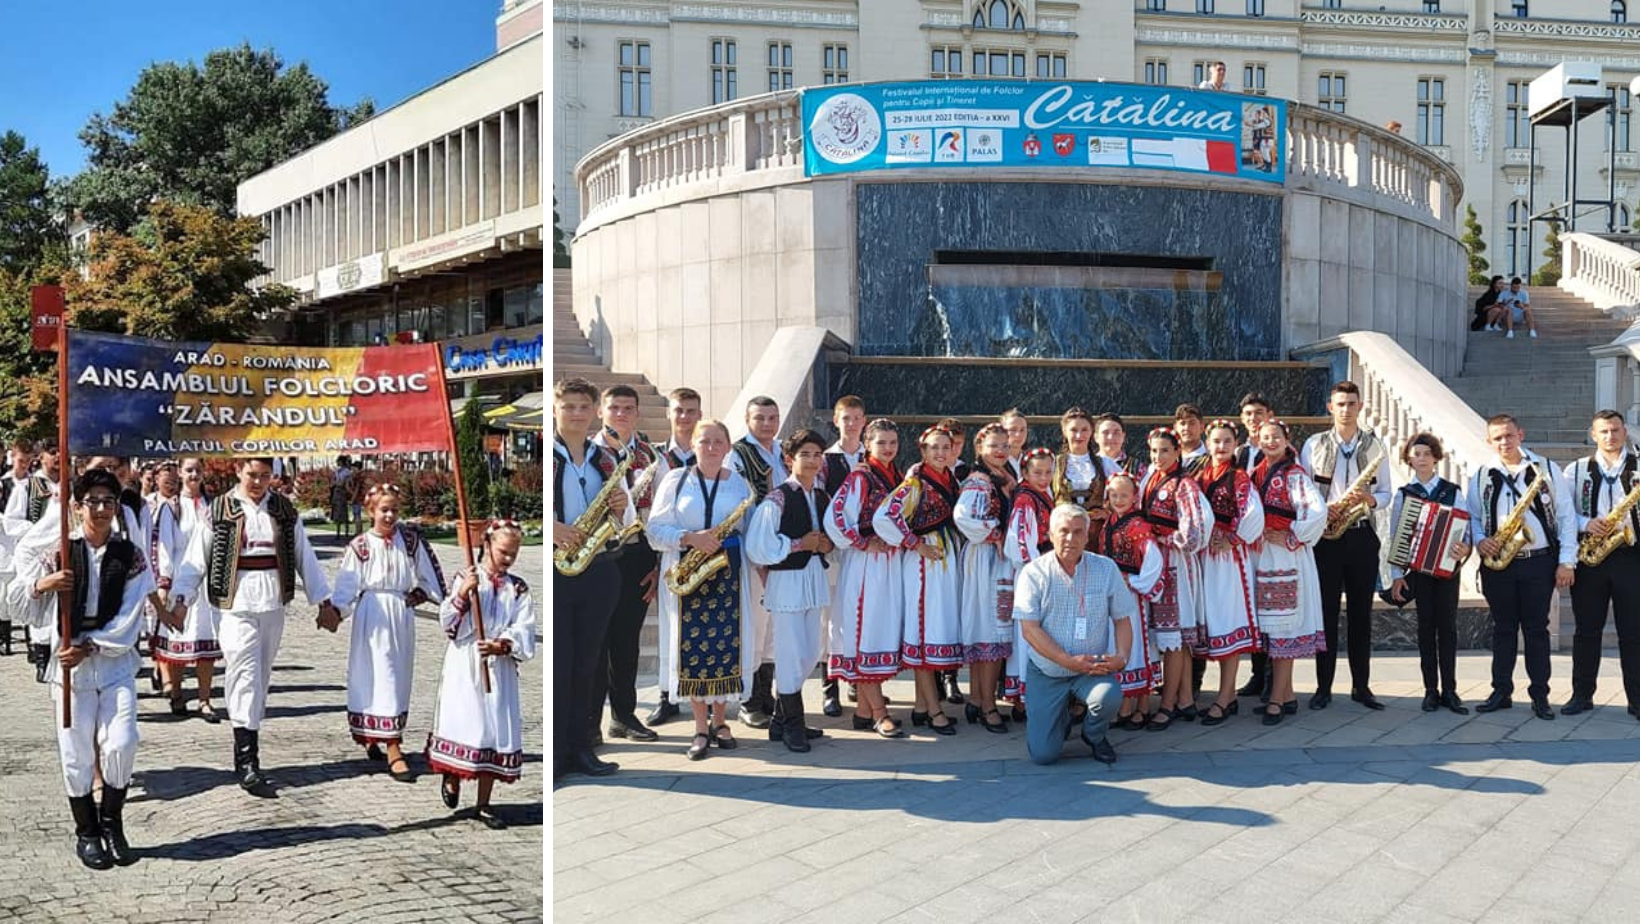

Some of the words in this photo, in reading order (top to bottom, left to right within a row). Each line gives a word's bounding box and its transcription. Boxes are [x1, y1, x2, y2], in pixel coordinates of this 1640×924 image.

[981, 86, 991, 94] de
[993, 86, 1024, 94] Folclor
[883, 99, 910, 108] pentru
[1024, 85, 1235, 131] Cătălina
[914, 115, 932, 123] IULIE
[992, 114, 1010, 122] XXVI
[173, 351, 225, 365] ARAD
[76, 364, 255, 395] ANSAMBLUL
[263, 373, 428, 396] FOLCLORIC
[143, 439, 225, 452] PALATUL
[230, 439, 317, 452] COPIILOR
[324, 437, 378, 450] ARAD
